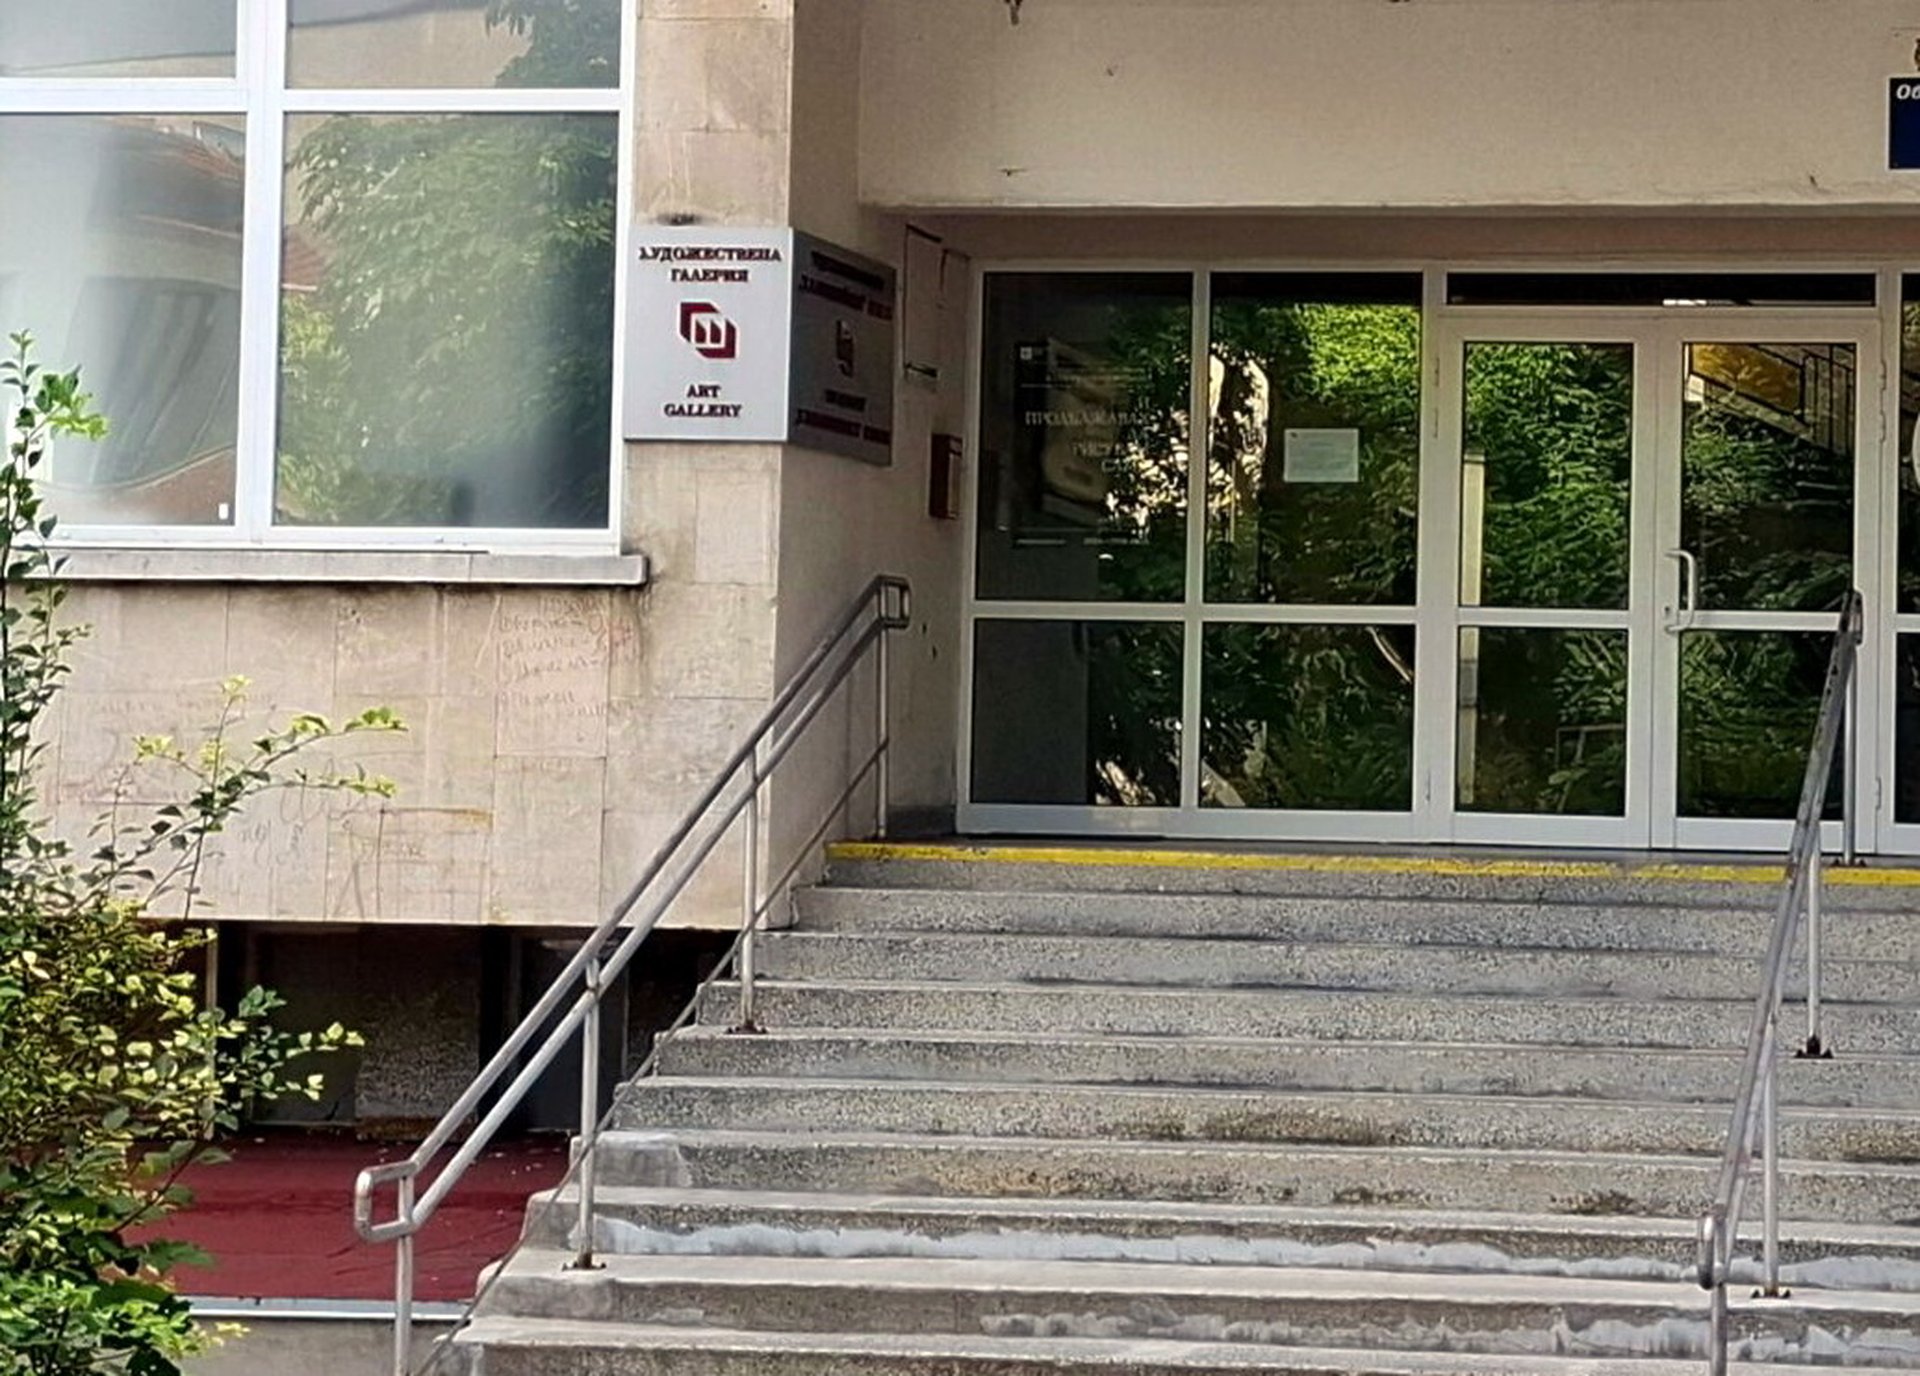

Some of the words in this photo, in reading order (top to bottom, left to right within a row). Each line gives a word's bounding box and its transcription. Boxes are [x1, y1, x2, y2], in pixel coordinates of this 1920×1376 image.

[671, 268, 749, 282] ГАЛЕРИЯ
[686, 384, 721, 399] ART
[663, 403, 742, 418] GALLERY
